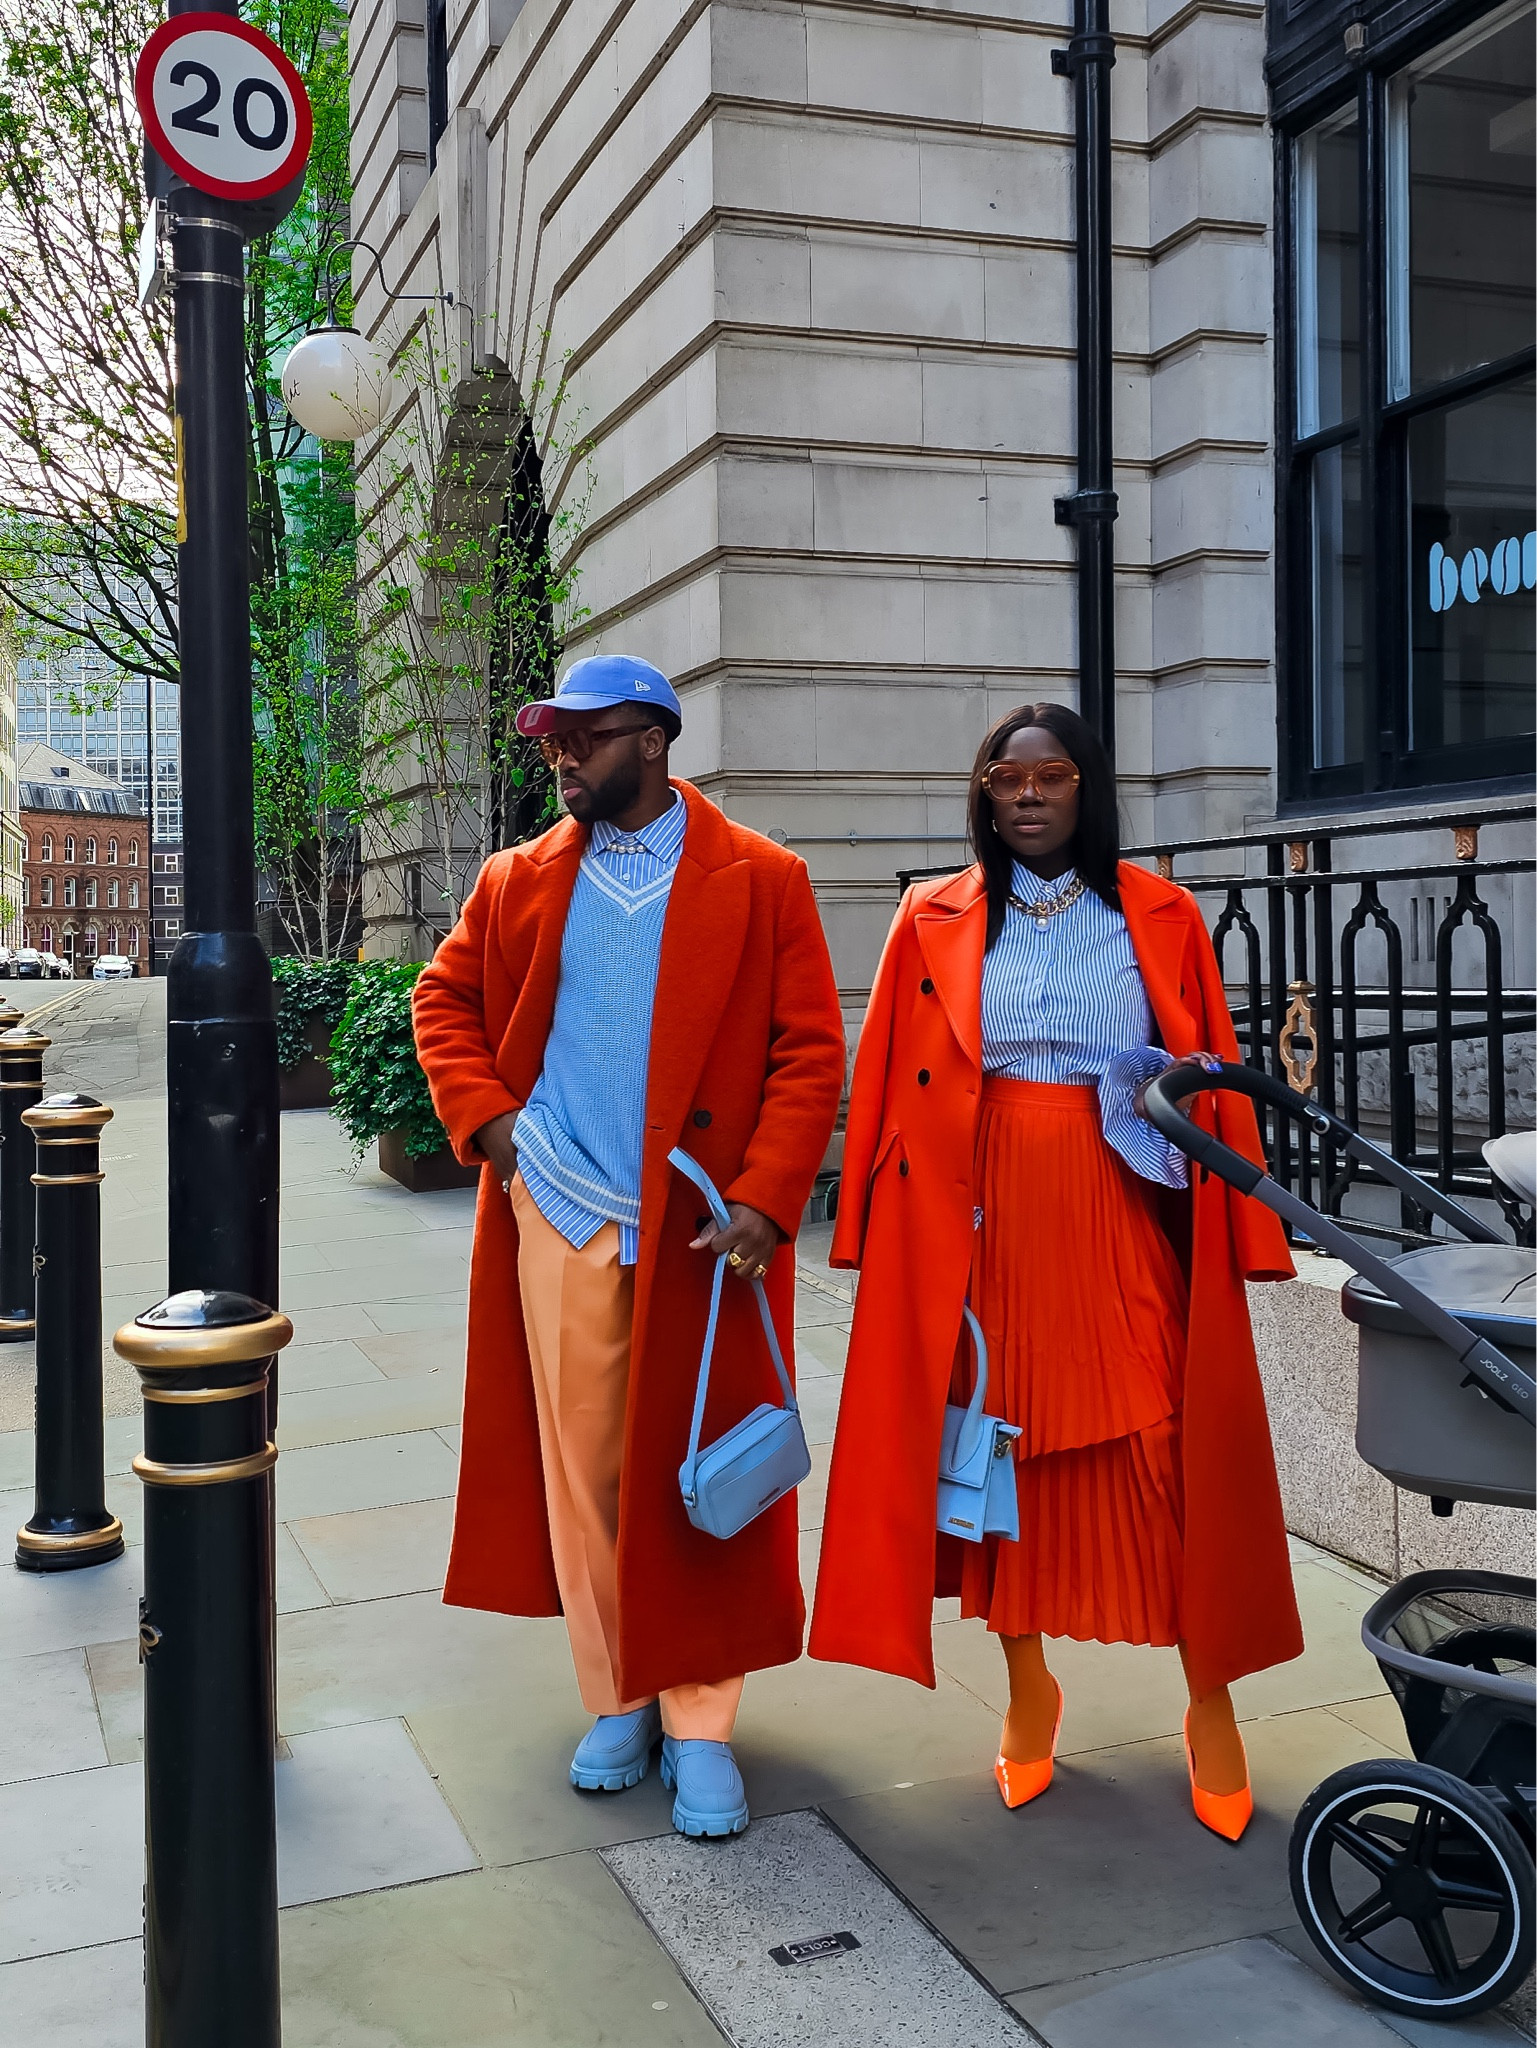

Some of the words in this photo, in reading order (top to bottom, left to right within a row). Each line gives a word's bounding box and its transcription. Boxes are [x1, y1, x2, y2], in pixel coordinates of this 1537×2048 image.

[170, 60, 289, 151] 20
[1480, 1359, 1509, 1382] JOOLZ
[1511, 1383, 1529, 1399] GEO
[799, 1940, 831, 1954] COLT
